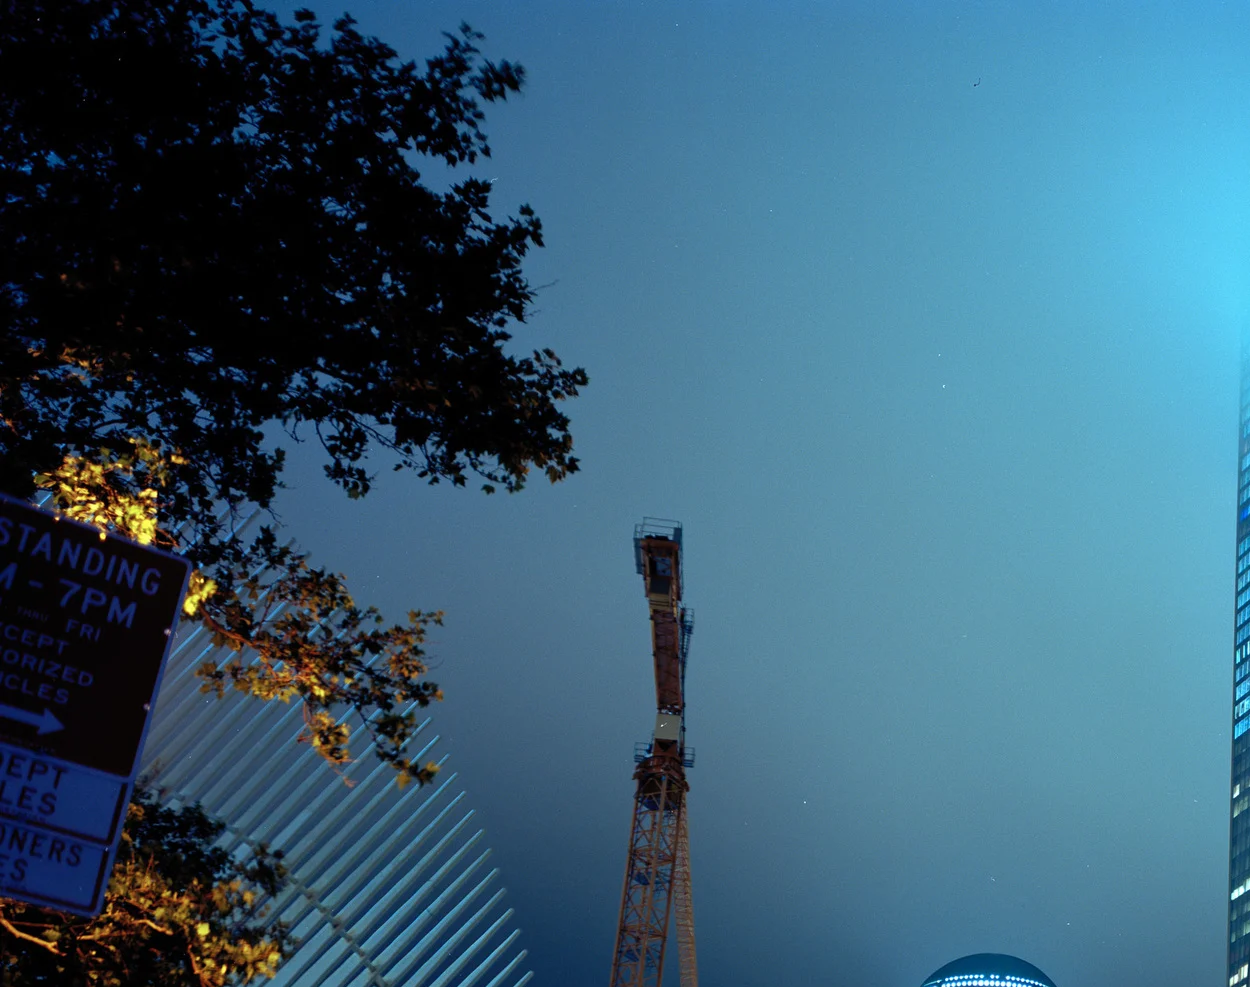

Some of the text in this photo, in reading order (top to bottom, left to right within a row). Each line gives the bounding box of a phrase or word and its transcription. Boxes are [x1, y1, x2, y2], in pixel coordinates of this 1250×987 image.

[60, 578, 137, 630] 7PM
[0, 621, 70, 656] CEPT
[65, 618, 101, 642] FRI
[0, 641, 94, 687] ORIZED
[0, 754, 69, 789] EPT
